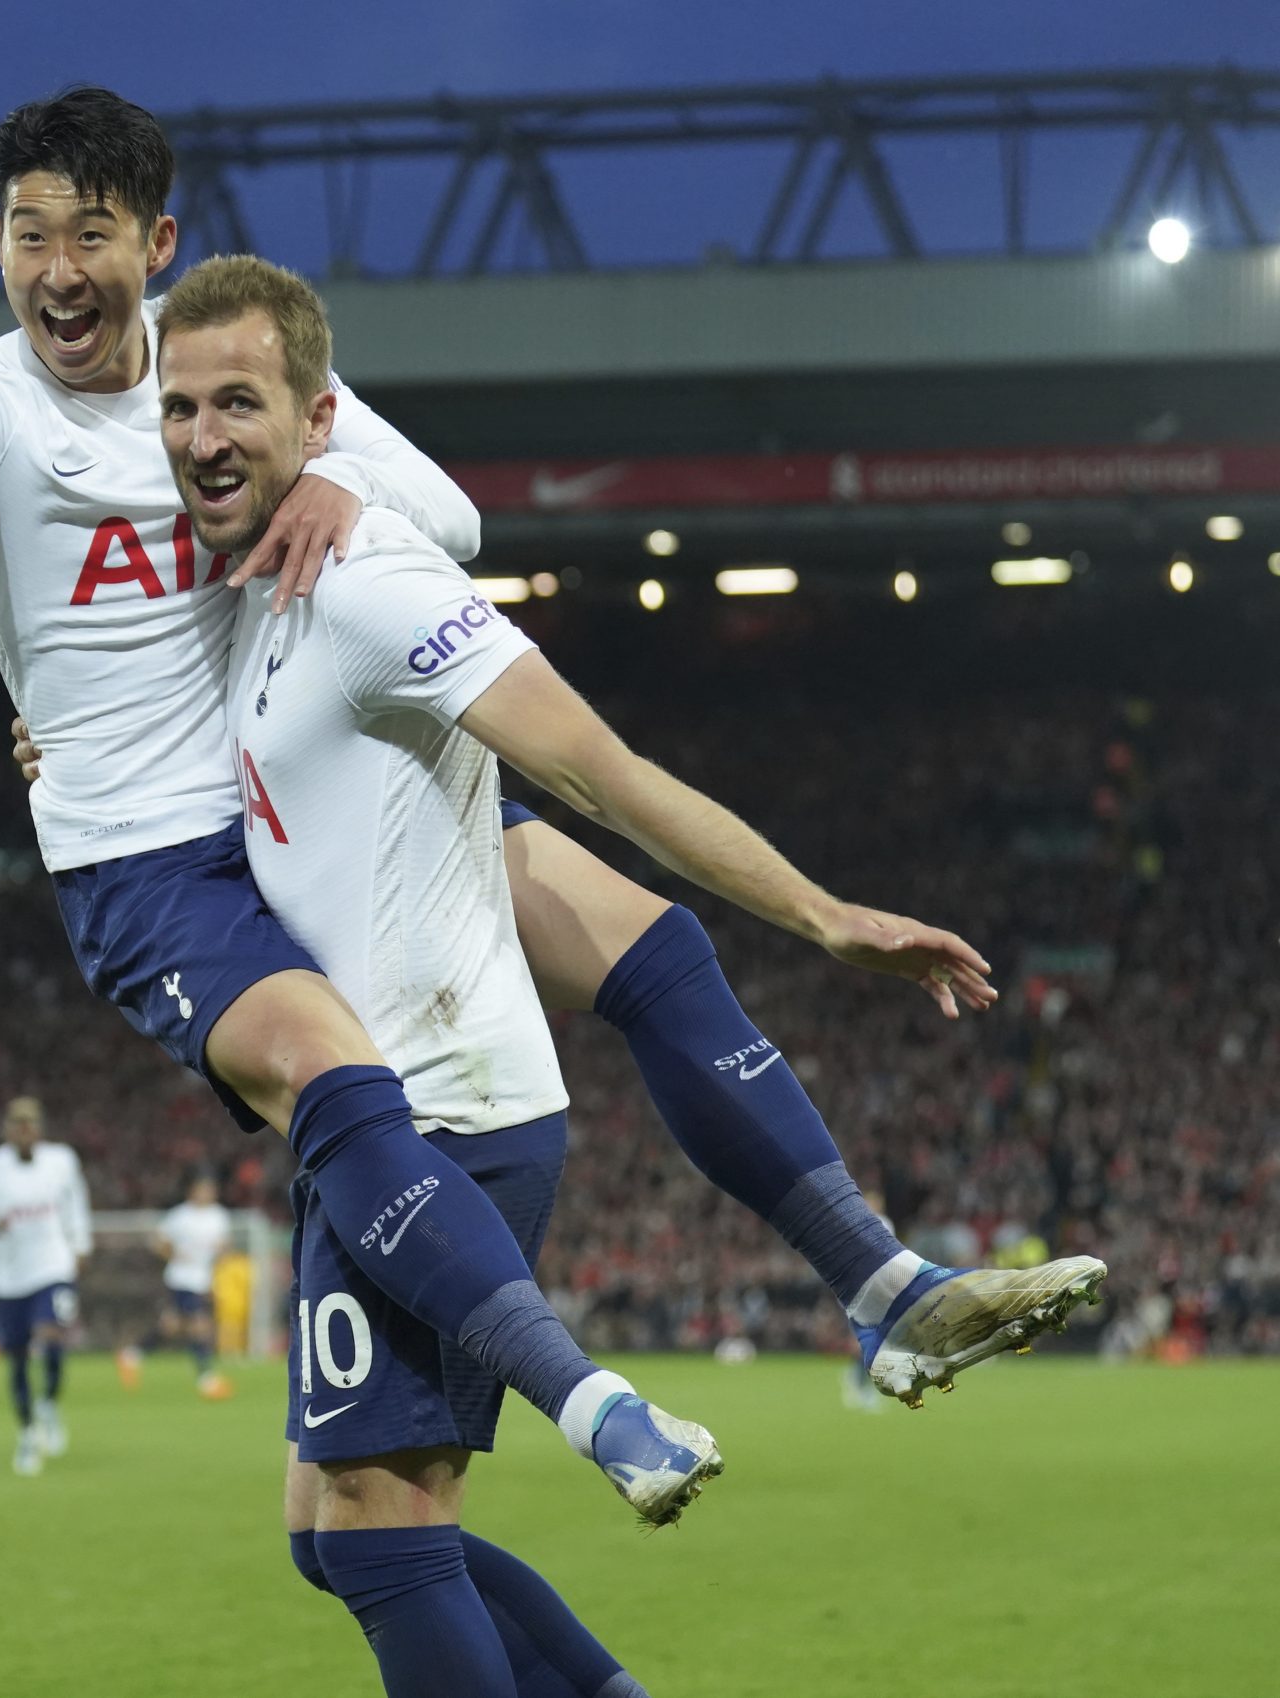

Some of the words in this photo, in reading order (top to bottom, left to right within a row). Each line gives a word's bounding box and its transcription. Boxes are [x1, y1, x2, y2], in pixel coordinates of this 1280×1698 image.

[408, 594, 495, 675] cinch
[714, 1038, 773, 1071] SPU
[360, 1175, 440, 1250] SPURS
[299, 1292, 373, 1394] 10
